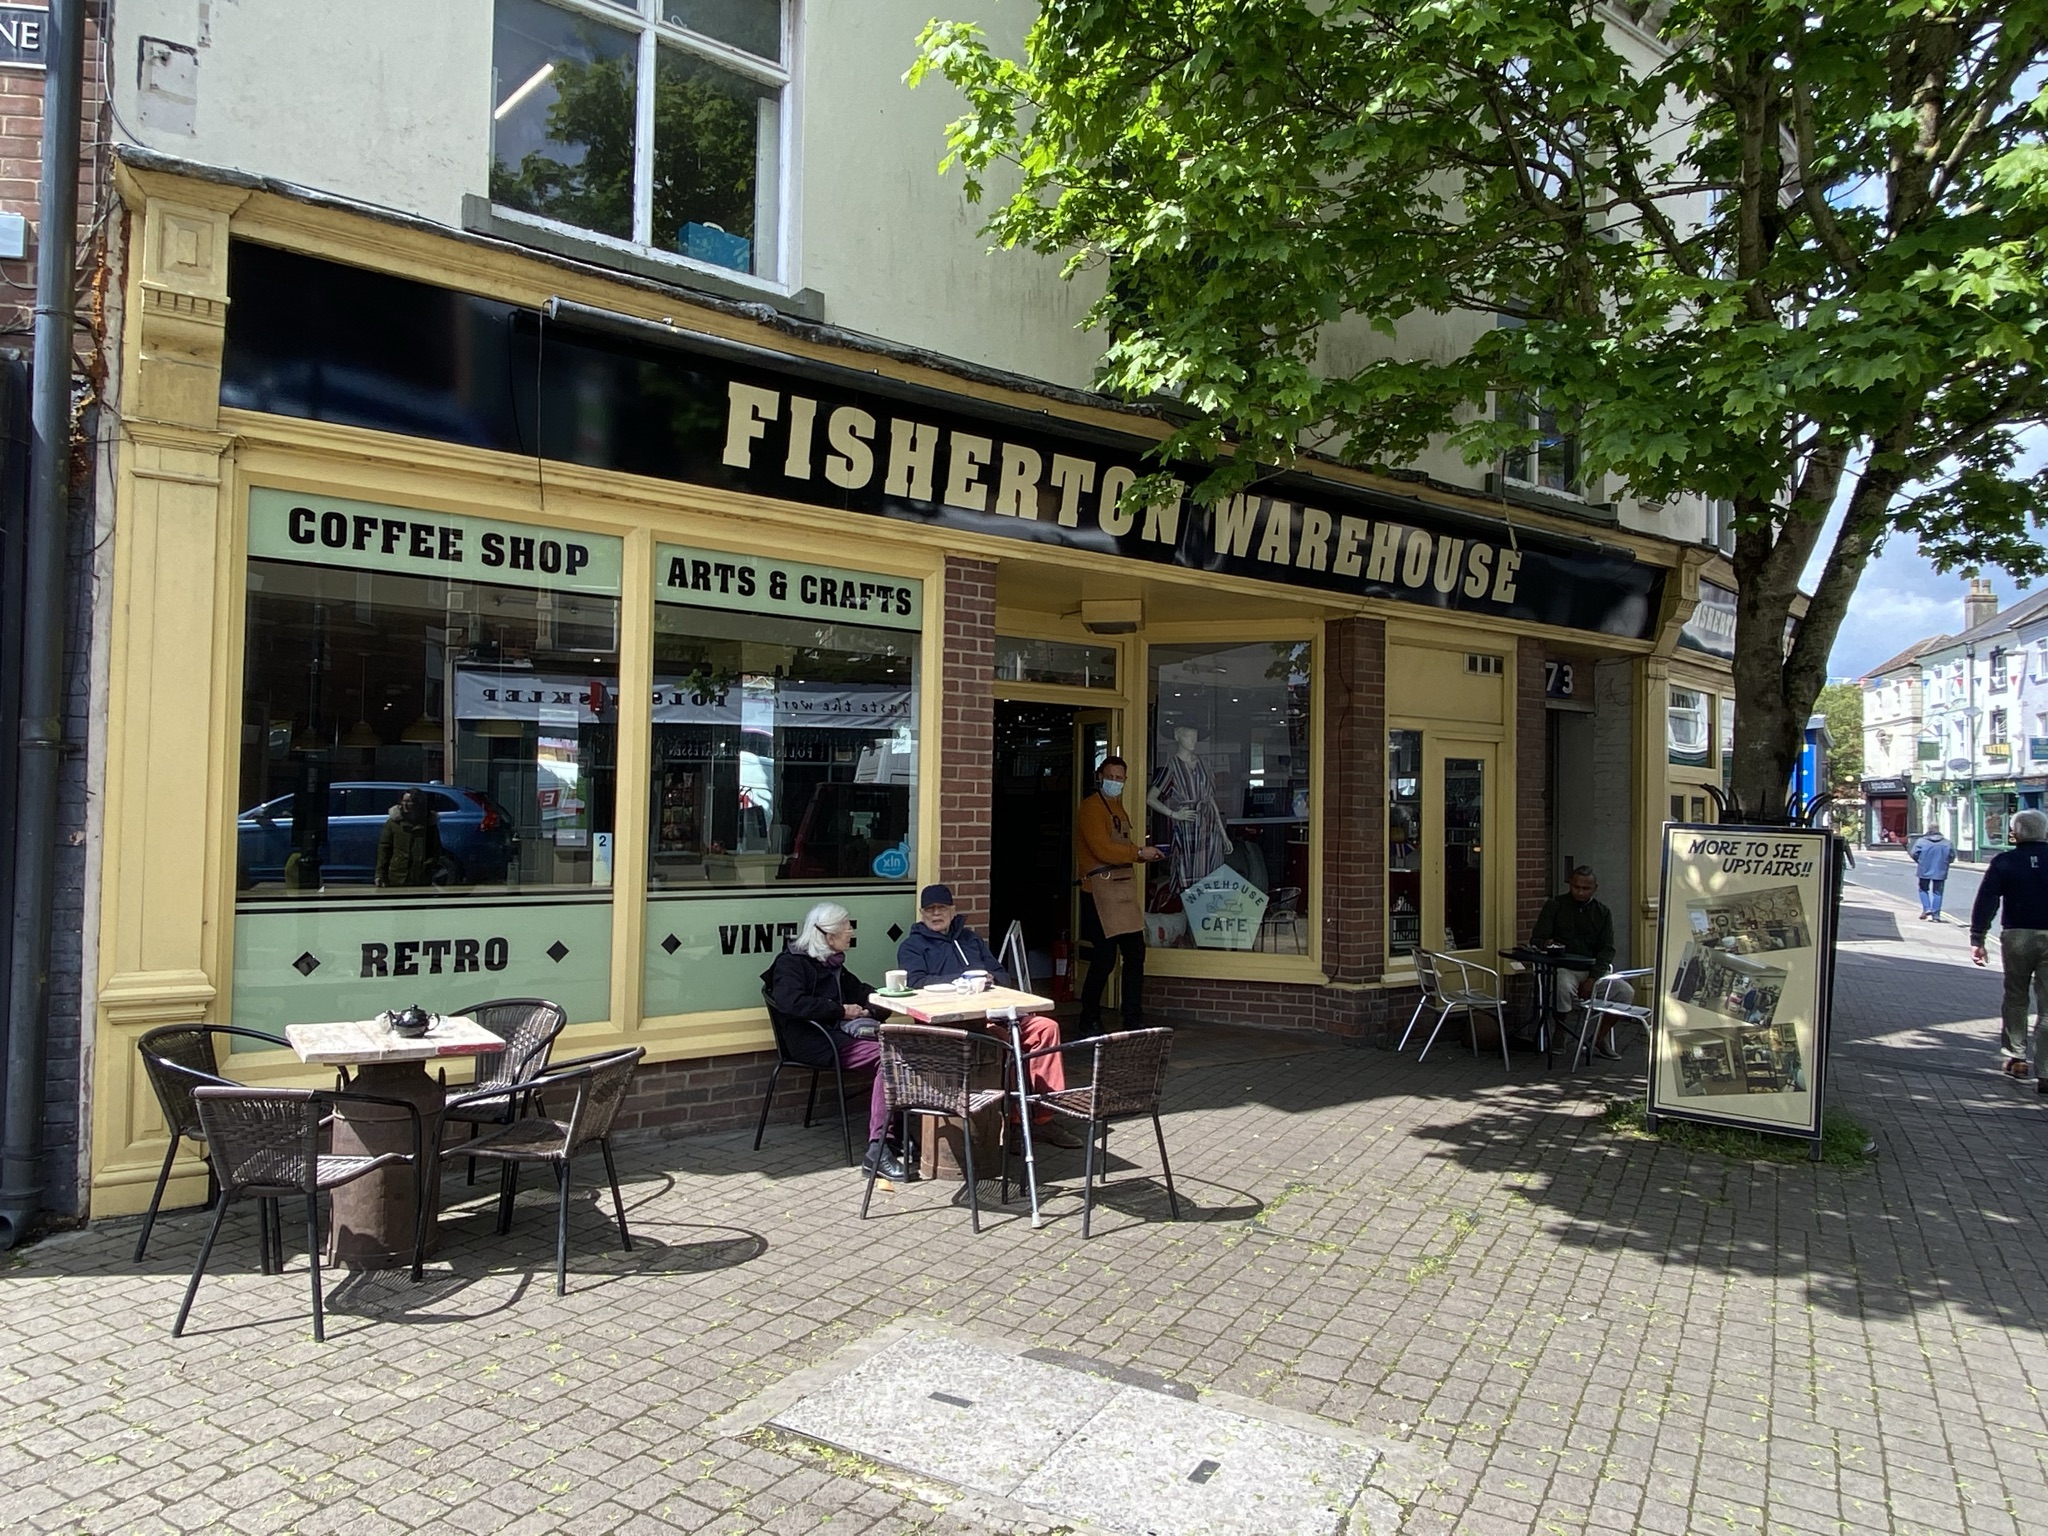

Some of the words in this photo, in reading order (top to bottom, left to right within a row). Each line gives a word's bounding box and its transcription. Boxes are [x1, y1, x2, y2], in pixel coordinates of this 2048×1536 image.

[723, 380, 1185, 545] FISHERTON
[1214, 493, 1523, 604] WAREHOUSE
[288, 507, 464, 563] COFFEE
[481, 533, 589, 576] SHOP
[667, 557, 756, 597] ARTS
[769, 570, 788, 600] &
[800, 575, 912, 616] CRAFTS
[1545, 661, 1574, 694] 73
[599, 835, 607, 847] 2
[1689, 839, 1742, 856] MORE
[1745, 842, 1769, 858] TO
[1773, 843, 1803, 859] SEE
[1722, 858, 1813, 878] UPSTAIRS!!
[1187, 880, 1264, 906] WAREHOUSE
[719, 920, 857, 955] VINT
[1201, 917, 1247, 932] CAFE
[360, 937, 509, 978] RETRO
